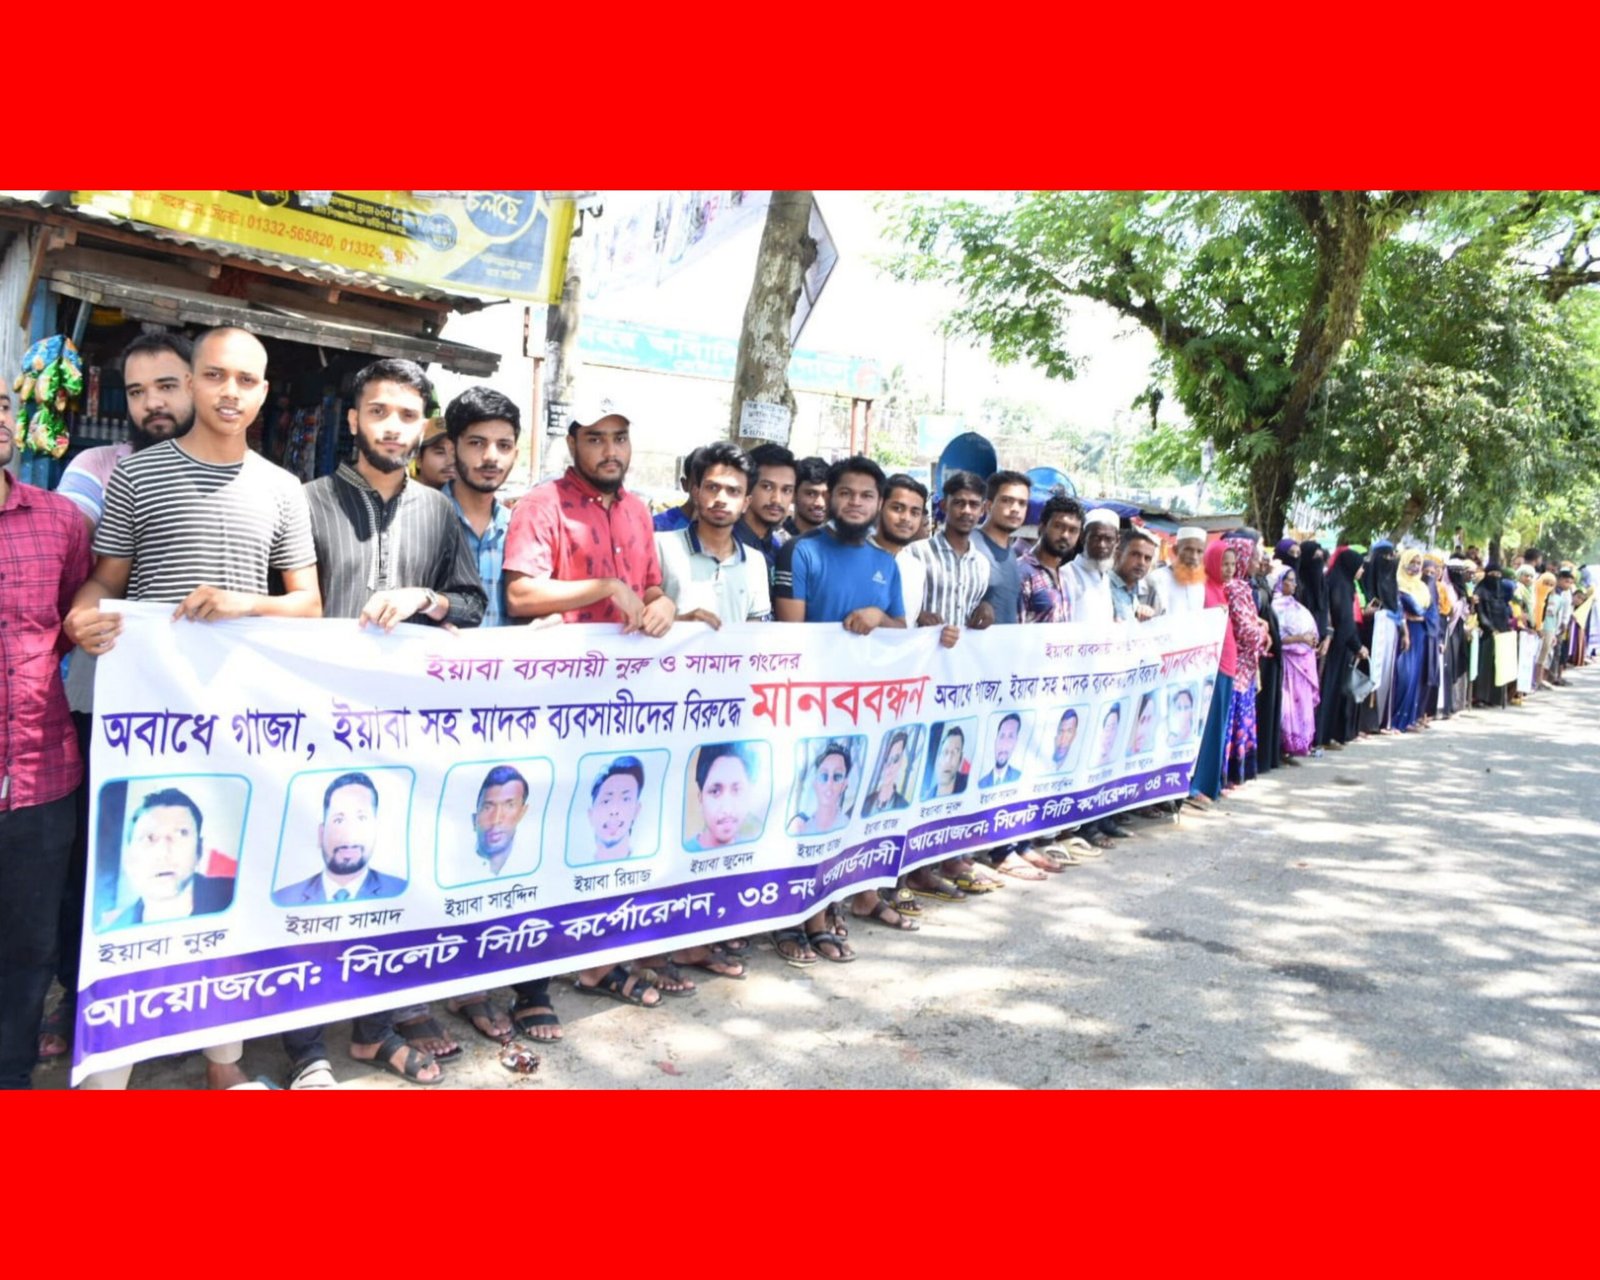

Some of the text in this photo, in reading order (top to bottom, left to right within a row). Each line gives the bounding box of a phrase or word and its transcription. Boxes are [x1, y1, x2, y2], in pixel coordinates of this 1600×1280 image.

[375, 207, 391, 219] ১০০
[426, 650, 802, 681] ইয়াবা ব্যবসায়ী নুরু ও সামাদ গংদের
[101, 676, 931, 760] অবাধে গাজা, ইয়াবা সহ মাদক ব্যবসায়ীদের বিরুদ্ধে মানববন্ধন
[993, 803, 1039, 833] সিলেট
[1041, 796, 1075, 820] সিটি
[1144, 775, 1162, 791] ৩৪
[690, 857, 721, 874] ইয়াবা
[573, 871, 610, 893] ইয়াবা
[444, 893, 484, 917] ইয়াবা
[285, 907, 405, 935] ইয়াবা সামাদ
[336, 936, 468, 983] সিলেট
[477, 919, 554, 959] সিটি
[563, 889, 726, 941] কর্পোরেশন,
[736, 885, 779, 906] ৩৪
[788, 877, 816, 900] নং
[98, 927, 229, 965] ইয়াবা নুরু
